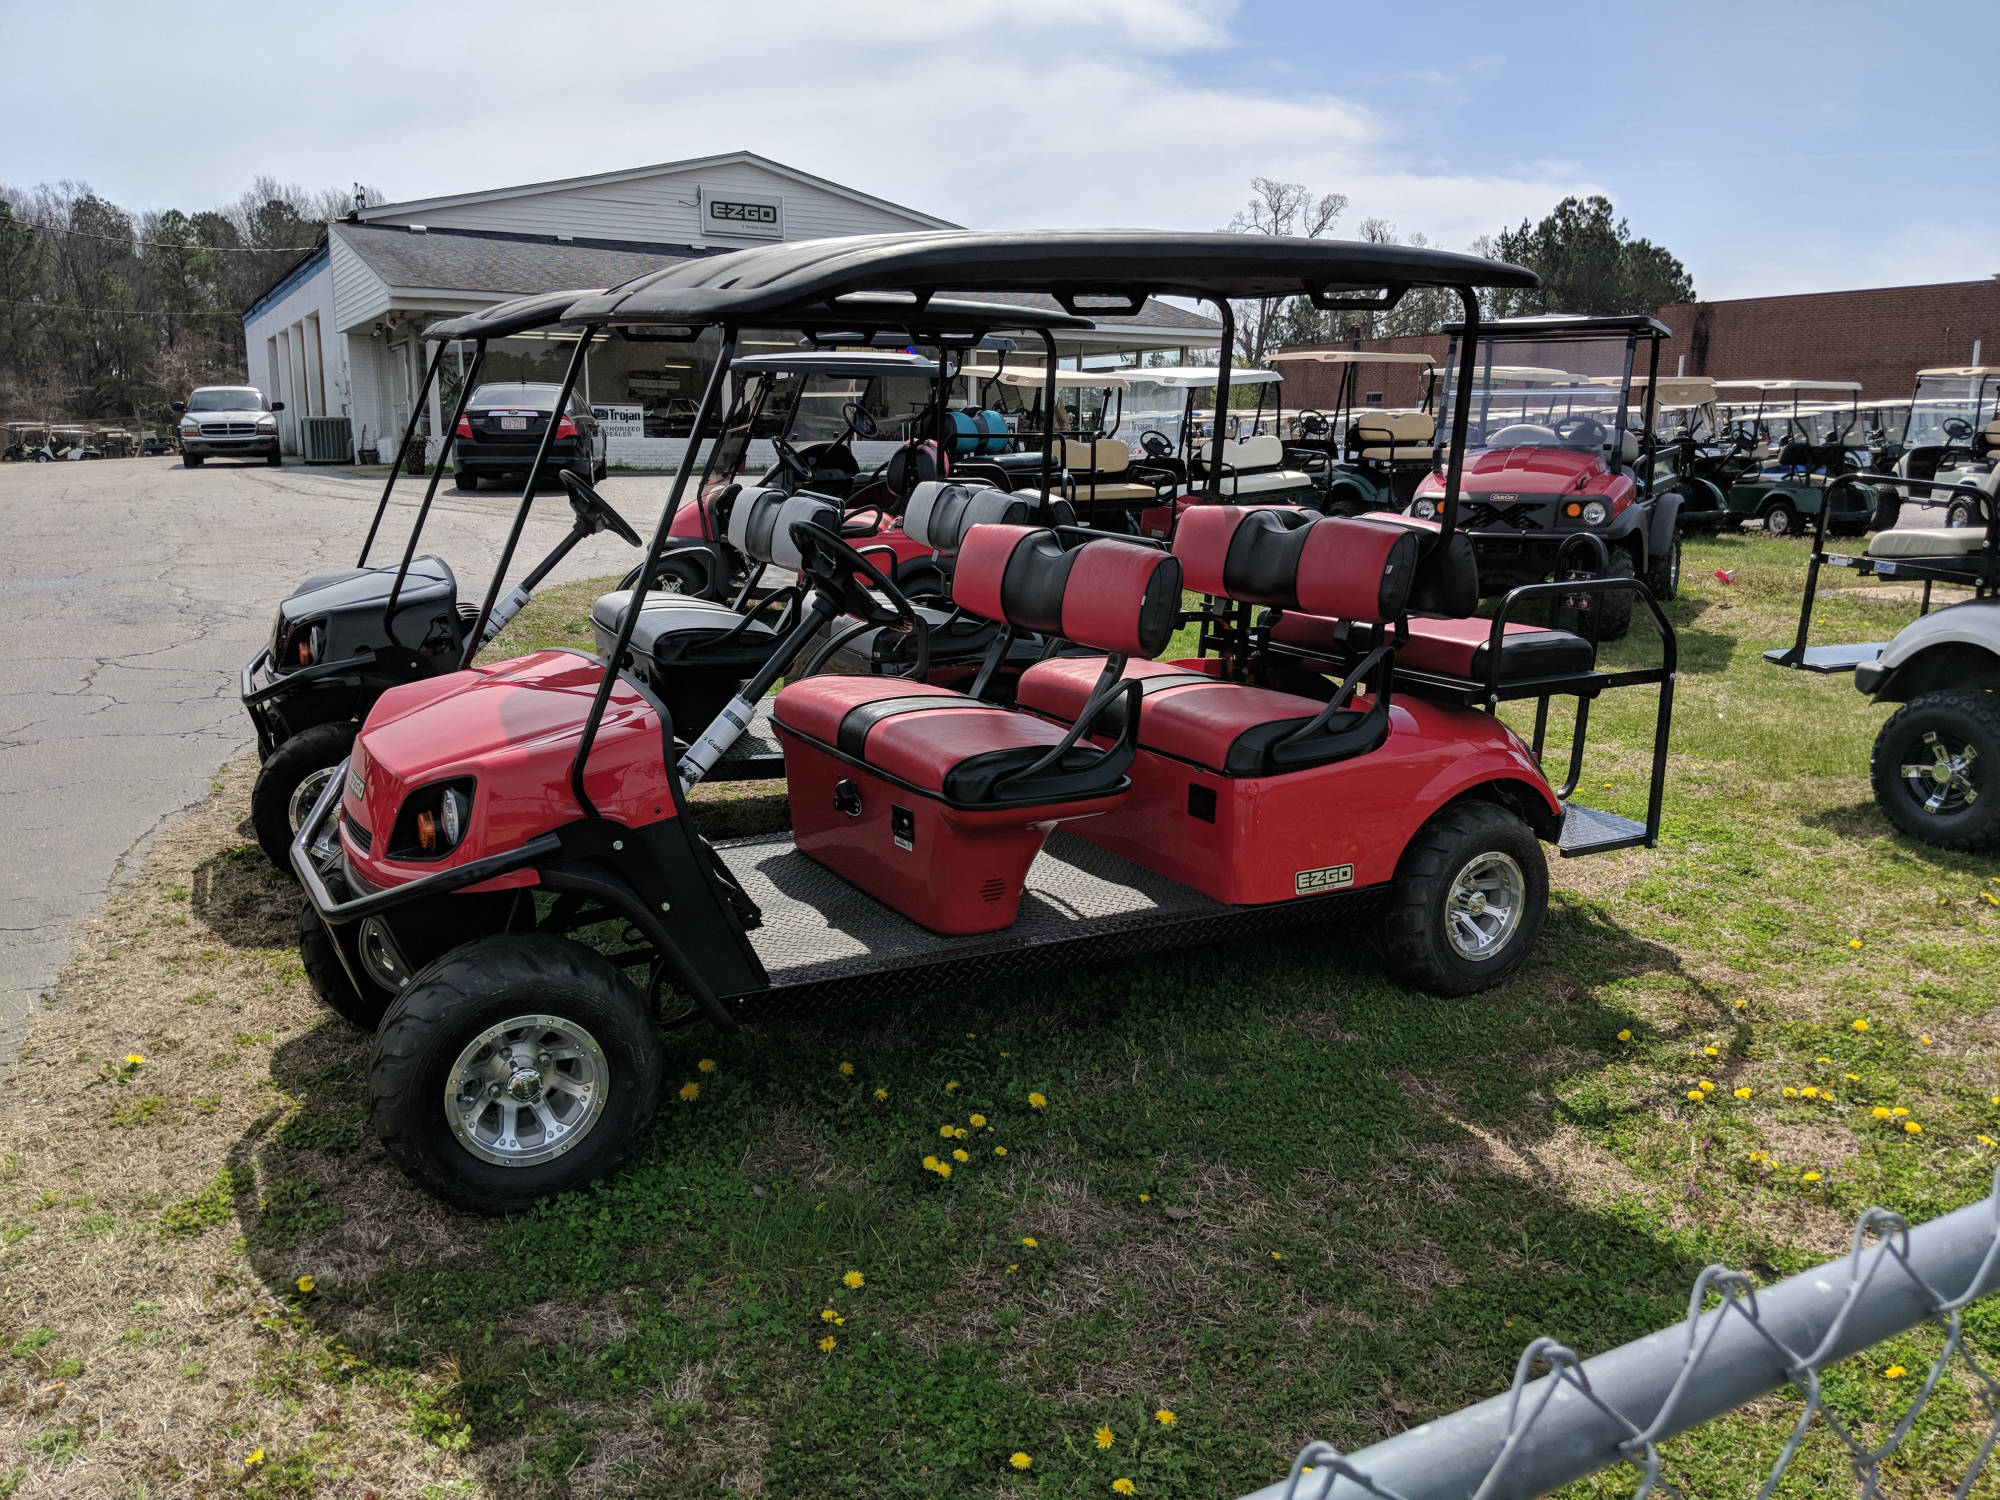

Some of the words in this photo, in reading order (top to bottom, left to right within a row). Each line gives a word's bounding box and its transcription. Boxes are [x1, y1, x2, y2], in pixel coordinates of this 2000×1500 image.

[712, 203, 774, 221] EZGO
[609, 409, 640, 423] Trojan
[708, 738, 724, 754] Guid
[1298, 866, 1351, 888] EZGO
